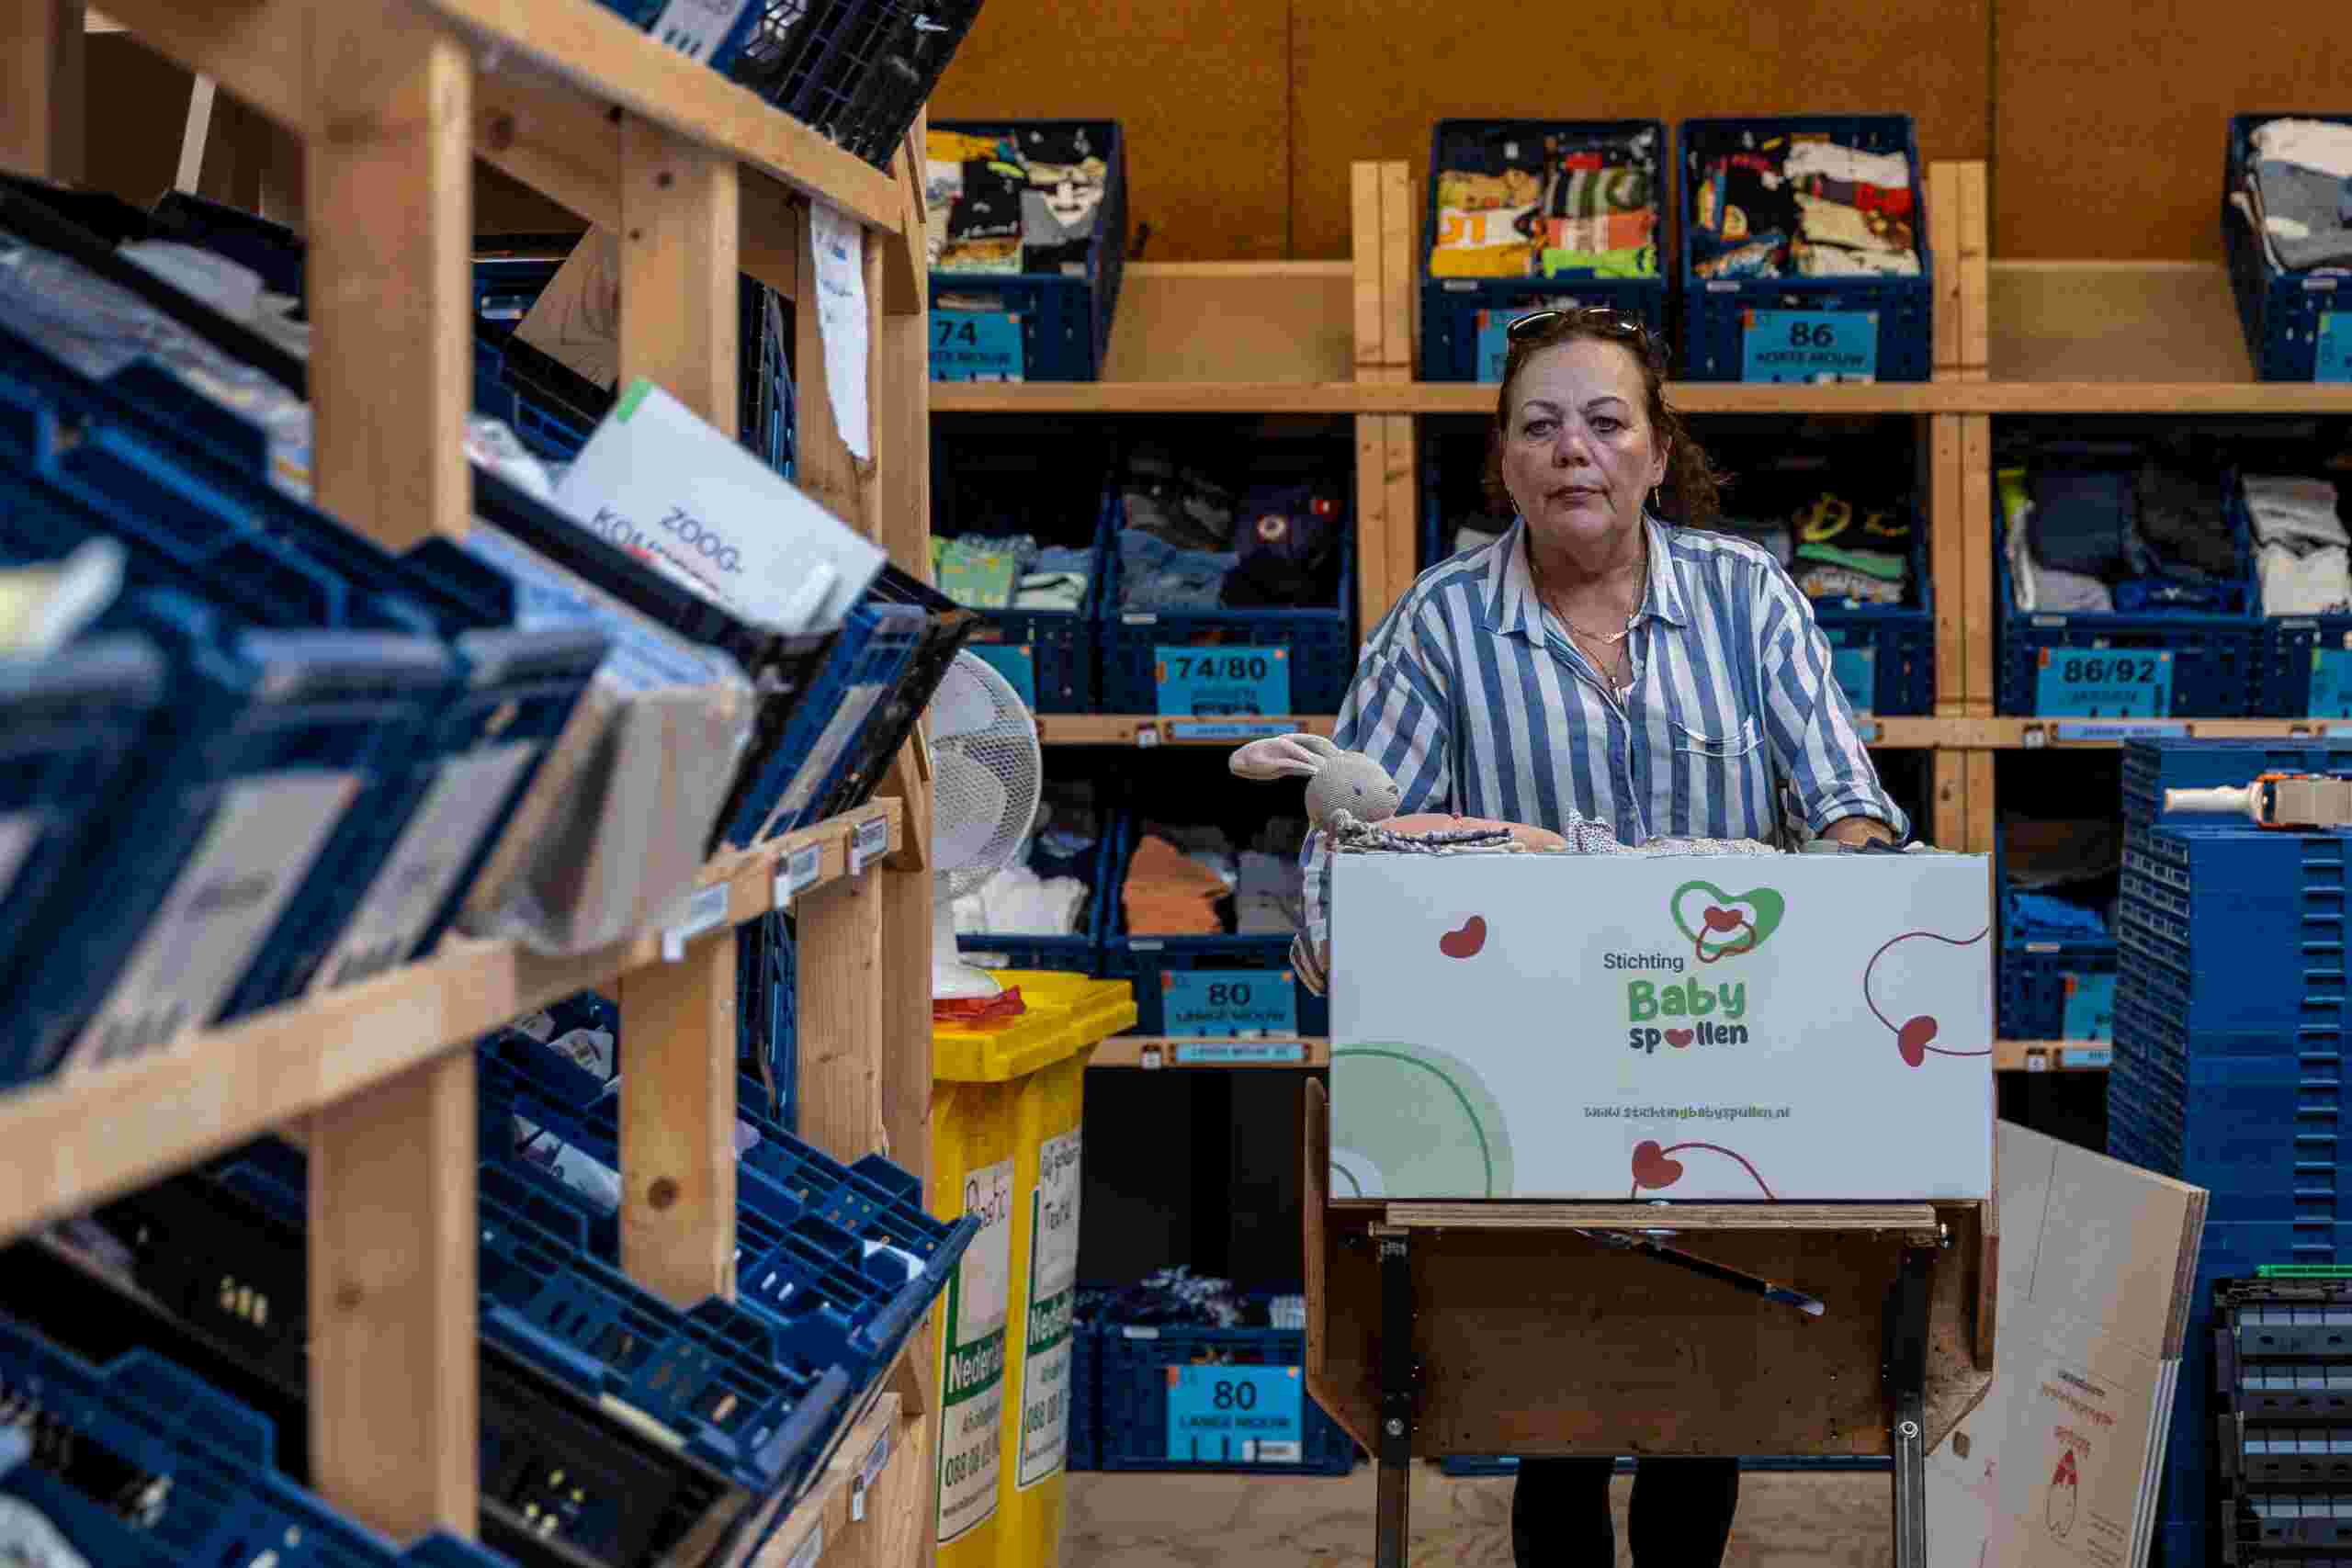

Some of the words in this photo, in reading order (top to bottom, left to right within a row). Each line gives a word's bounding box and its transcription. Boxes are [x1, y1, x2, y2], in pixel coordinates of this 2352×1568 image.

[936, 320, 978, 347] 74
[1790, 322, 1835, 347] 86
[656, 506, 743, 573] ZOOG-
[1175, 657, 1266, 681] 74/80
[2064, 659, 2155, 683] 86/92
[1602, 953, 1685, 973] Stichting
[1208, 982, 1251, 1008] 80
[1628, 976, 1747, 1021] Baby
[1214, 1381, 1258, 1410] 80
